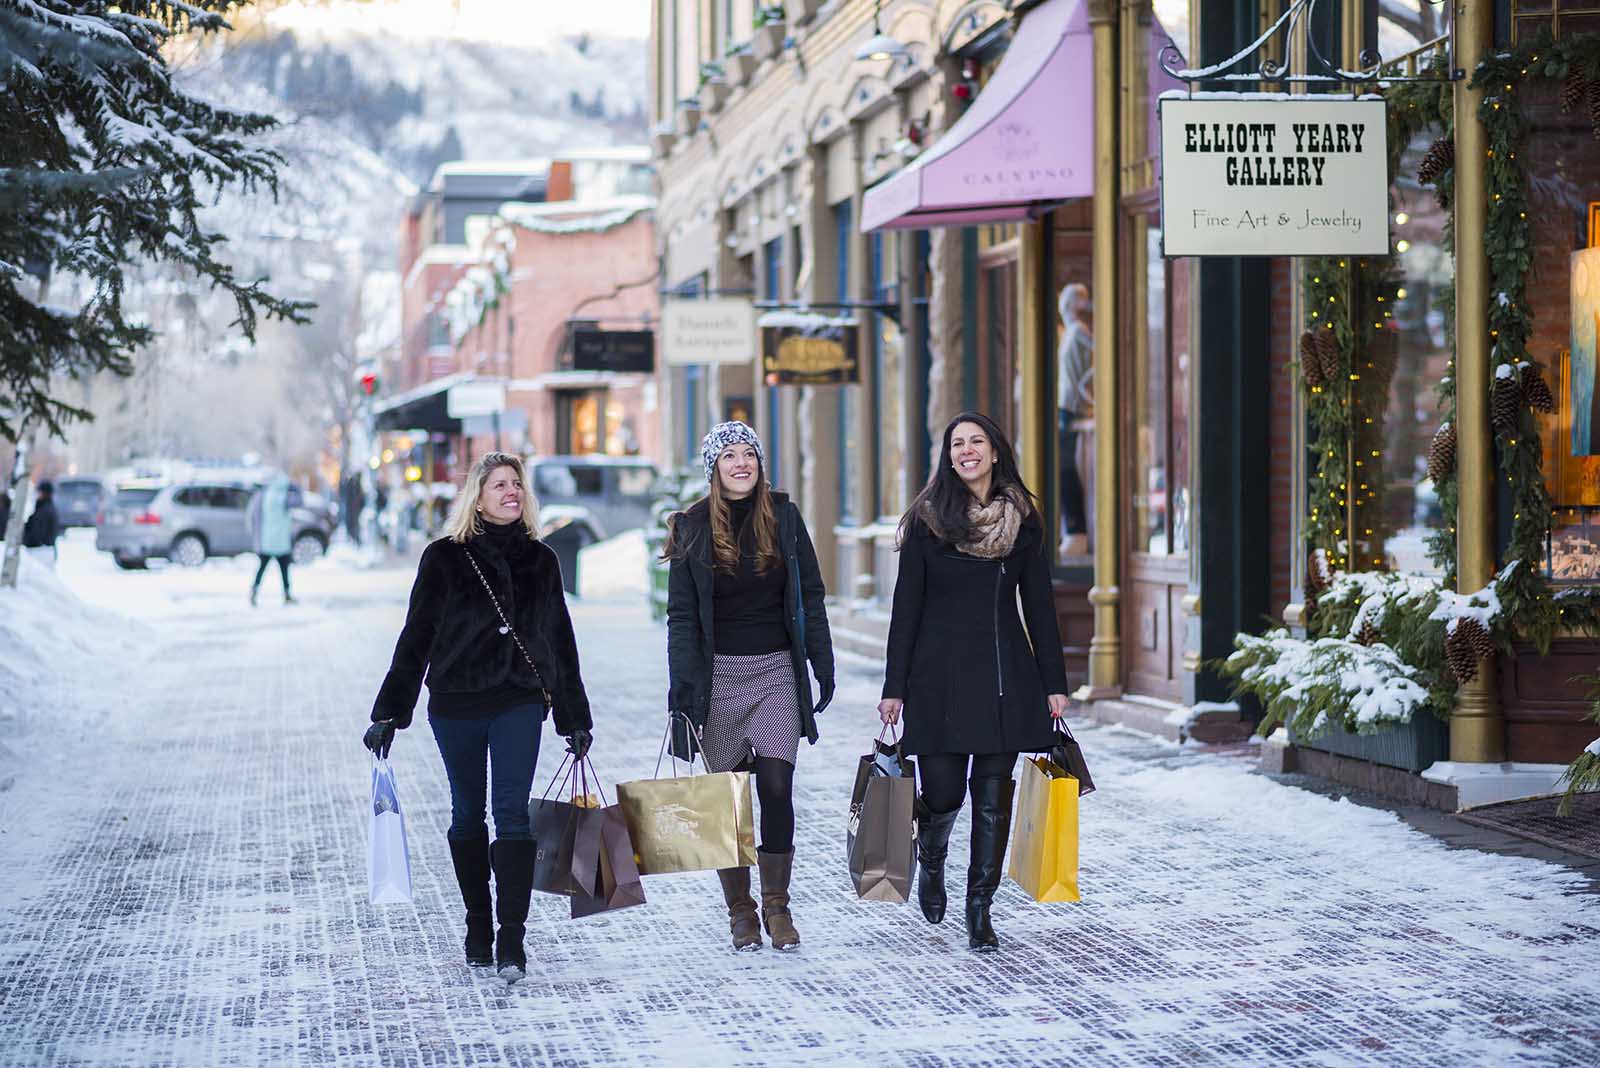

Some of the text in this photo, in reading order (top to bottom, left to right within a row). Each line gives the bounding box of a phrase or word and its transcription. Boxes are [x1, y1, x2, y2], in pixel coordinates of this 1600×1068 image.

[1184, 123, 1365, 153] ELLIOTT YEARY
[1226, 156, 1326, 186] GALLERY
[1192, 208, 1362, 233] Fine Art & Jewelry
